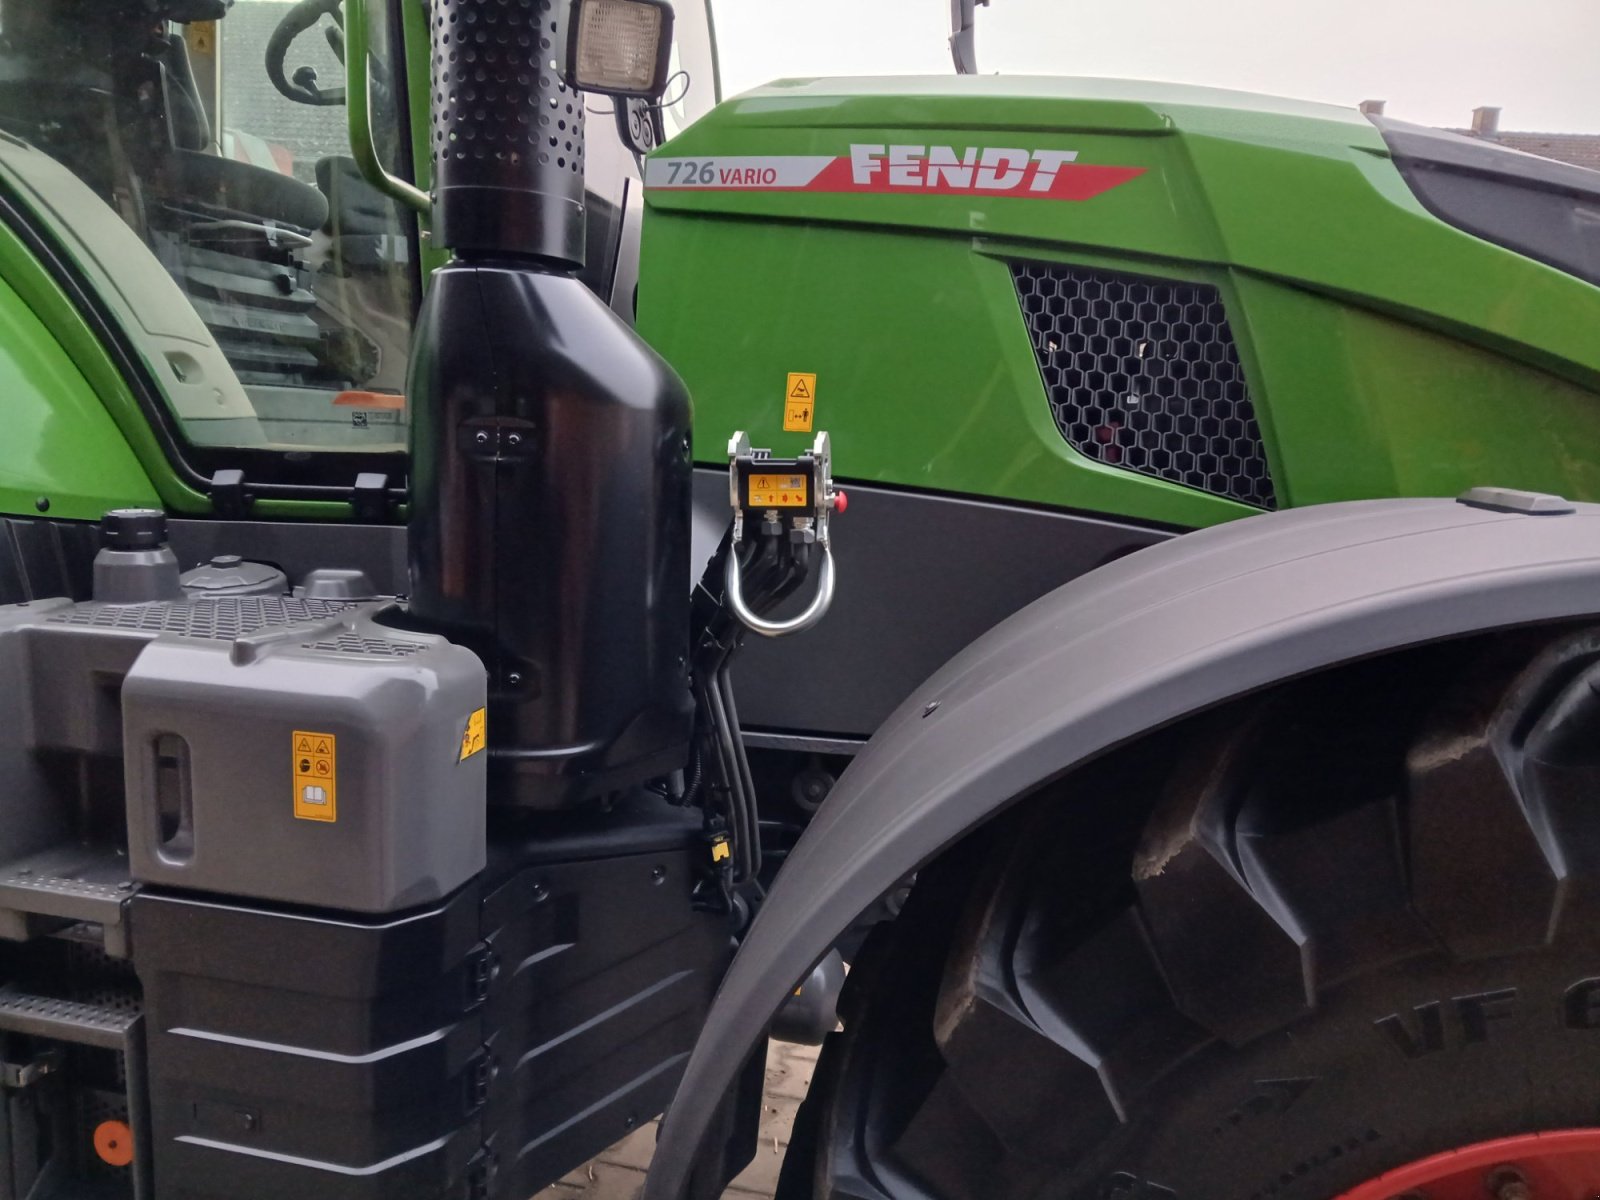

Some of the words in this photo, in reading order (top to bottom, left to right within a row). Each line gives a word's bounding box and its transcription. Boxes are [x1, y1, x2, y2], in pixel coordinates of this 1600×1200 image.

[667, 161, 715, 185] 726
[719, 168, 777, 185] VARIO
[849, 143, 1079, 191] FENDT
[1373, 987, 1517, 1060] VF
